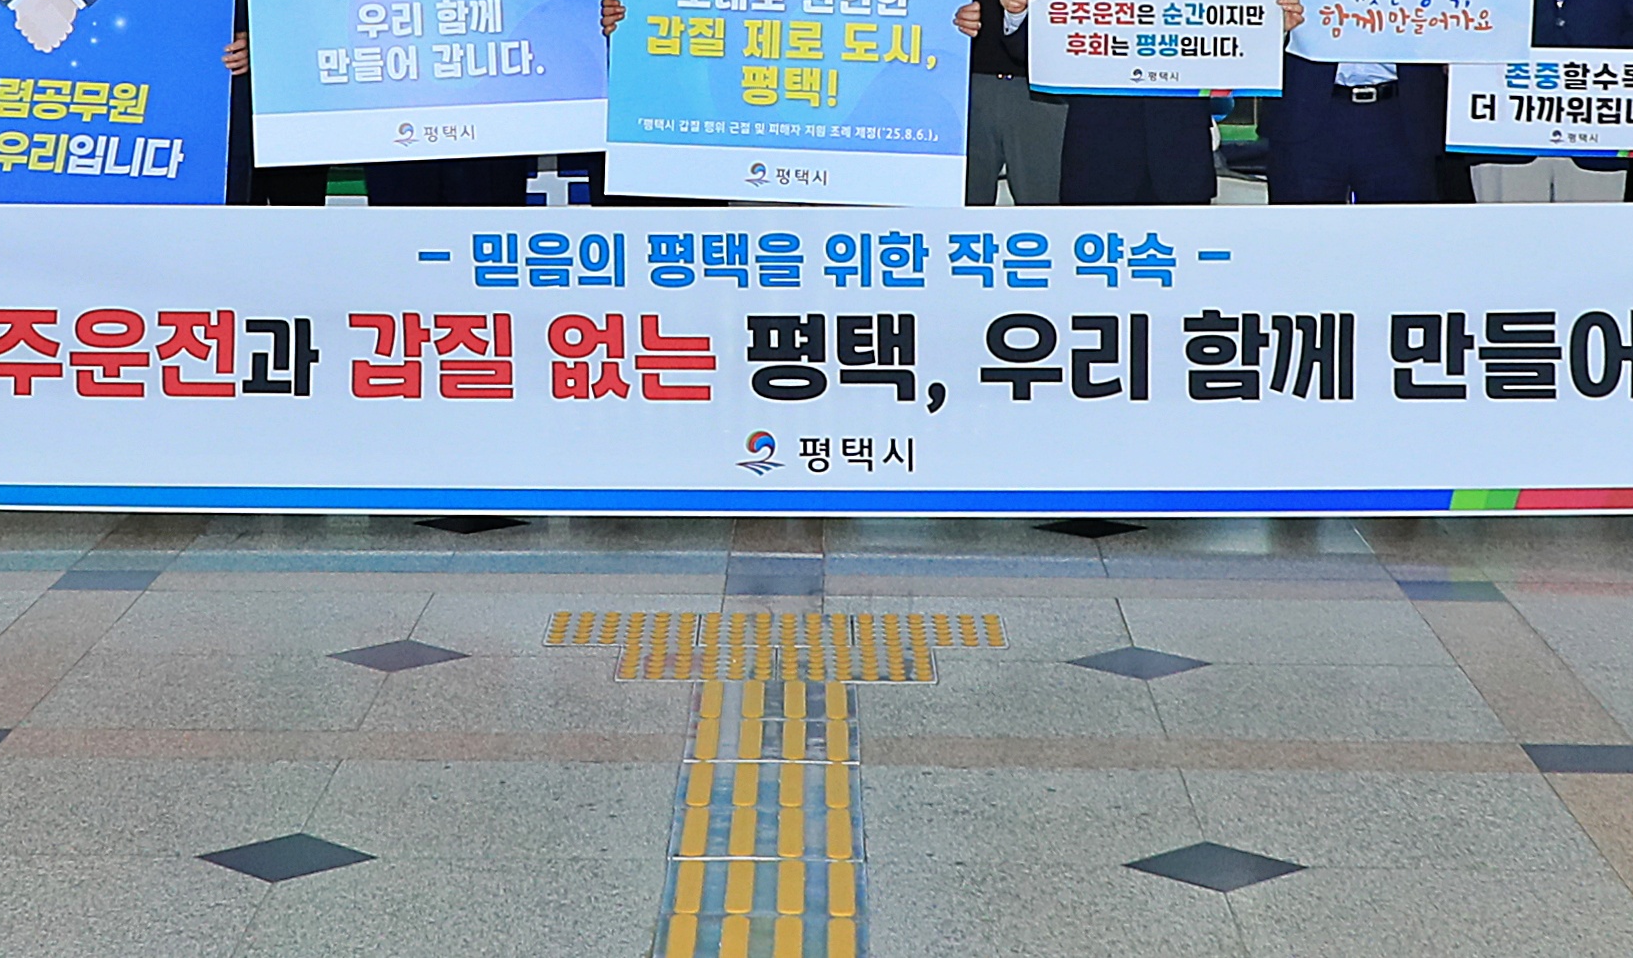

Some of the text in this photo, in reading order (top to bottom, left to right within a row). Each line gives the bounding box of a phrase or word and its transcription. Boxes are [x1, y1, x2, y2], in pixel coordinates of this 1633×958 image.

[357, 2, 422, 38] 우리
[1049, 2, 1264, 26] 음주운전은 순간이지만
[1319, 4, 1493, 38] 함께 만들어가요
[647, 16, 937, 70] 갑질 제로 도시,
[1066, 33, 1244, 57] 후회는 평생입니다.
[318, 41, 545, 84] 만들어 갑니다.
[1148, 72, 1179, 82] 평택시
[741, 65, 839, 107] 평택!
[1471, 94, 1496, 121] 더
[423, 125, 475, 142] 평택시
[679, 120, 699, 133] 갑질
[729, 121, 750, 133] 근절
[755, 122, 765, 135] 및
[769, 123, 801, 136] 피해자
[805, 124, 826, 137] 지원
[830, 125, 851, 138] 조례
[776, 168, 827, 185] 평택시
[471, 233, 1177, 288] 믿음의 평택을 위한 작은 약속
[348, 309, 515, 400] 갑질
[548, 312, 717, 402] 없는
[745, 312, 946, 414] 평택,
[978, 310, 1151, 402] 우리
[1181, 309, 1355, 402] 함께
[798, 435, 916, 473] 평택시
